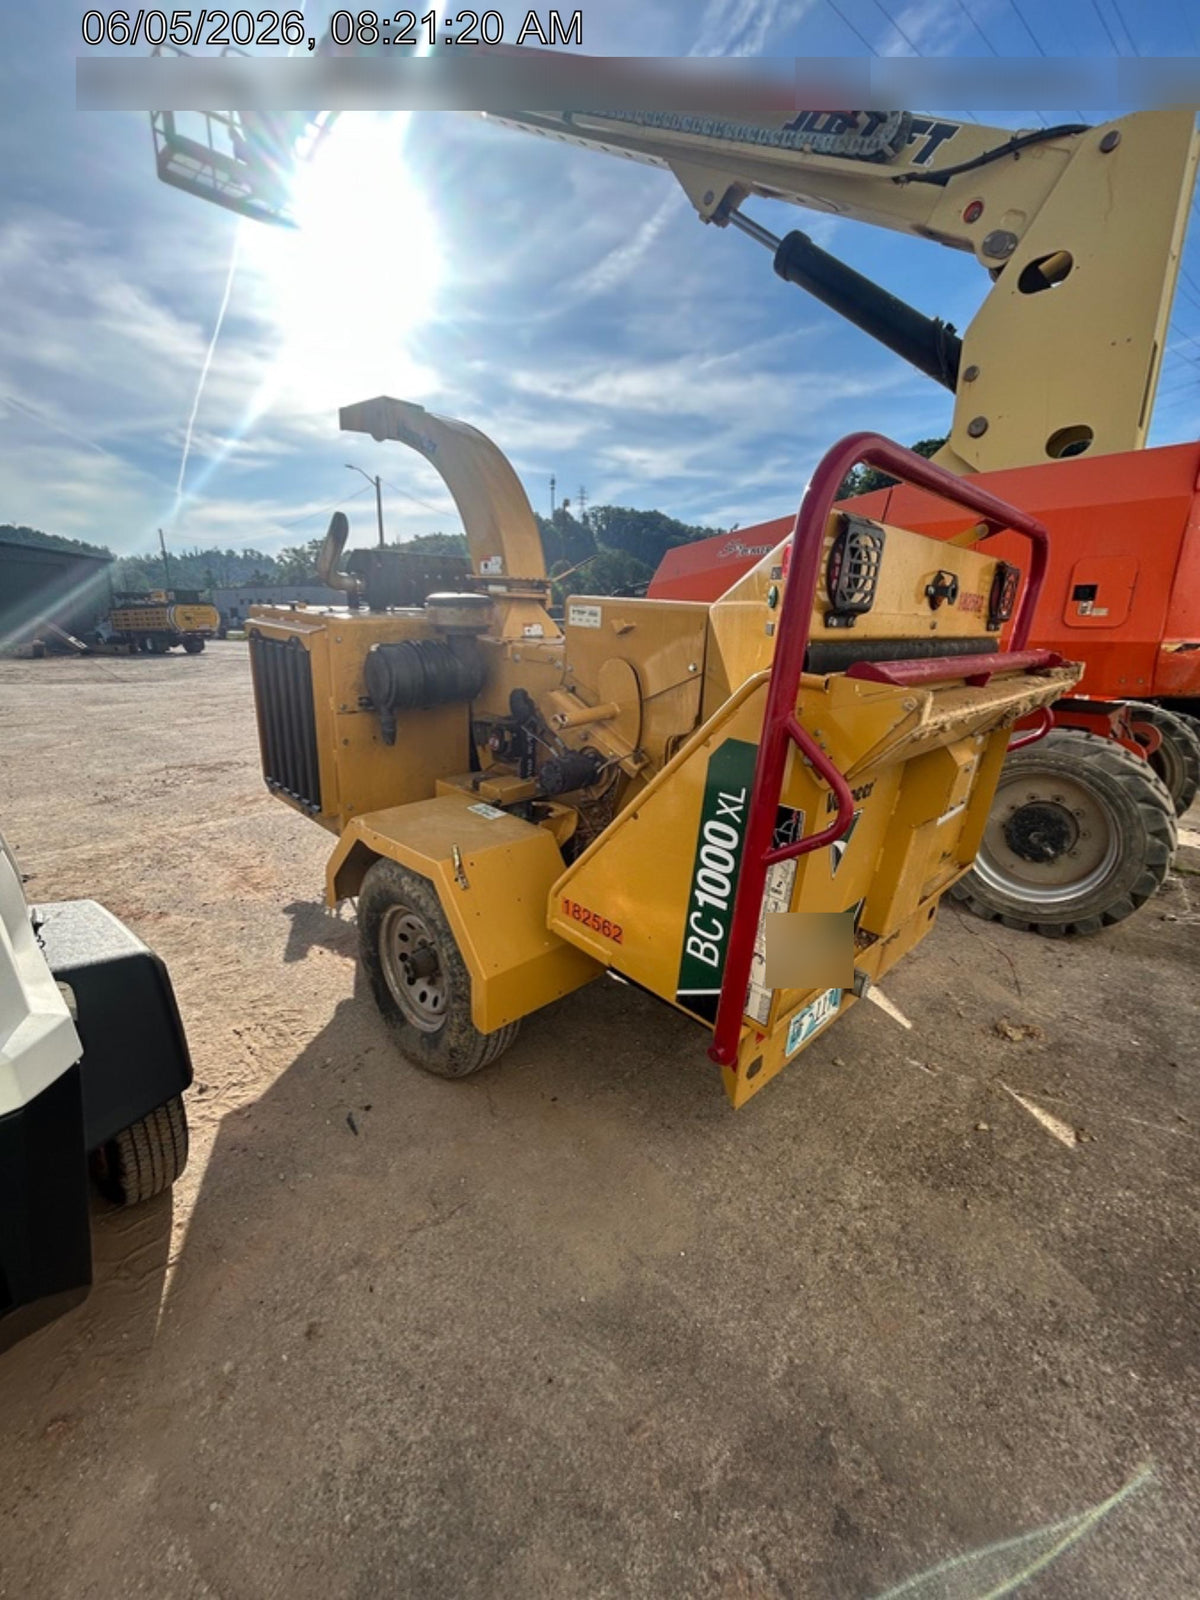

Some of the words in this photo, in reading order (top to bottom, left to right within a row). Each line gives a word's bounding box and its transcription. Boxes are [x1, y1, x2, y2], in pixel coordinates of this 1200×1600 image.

[716, 787, 746, 823] XL
[694, 820, 739, 911] 1000
[563, 897, 624, 945] 182562
[686, 911, 724, 967] BC
